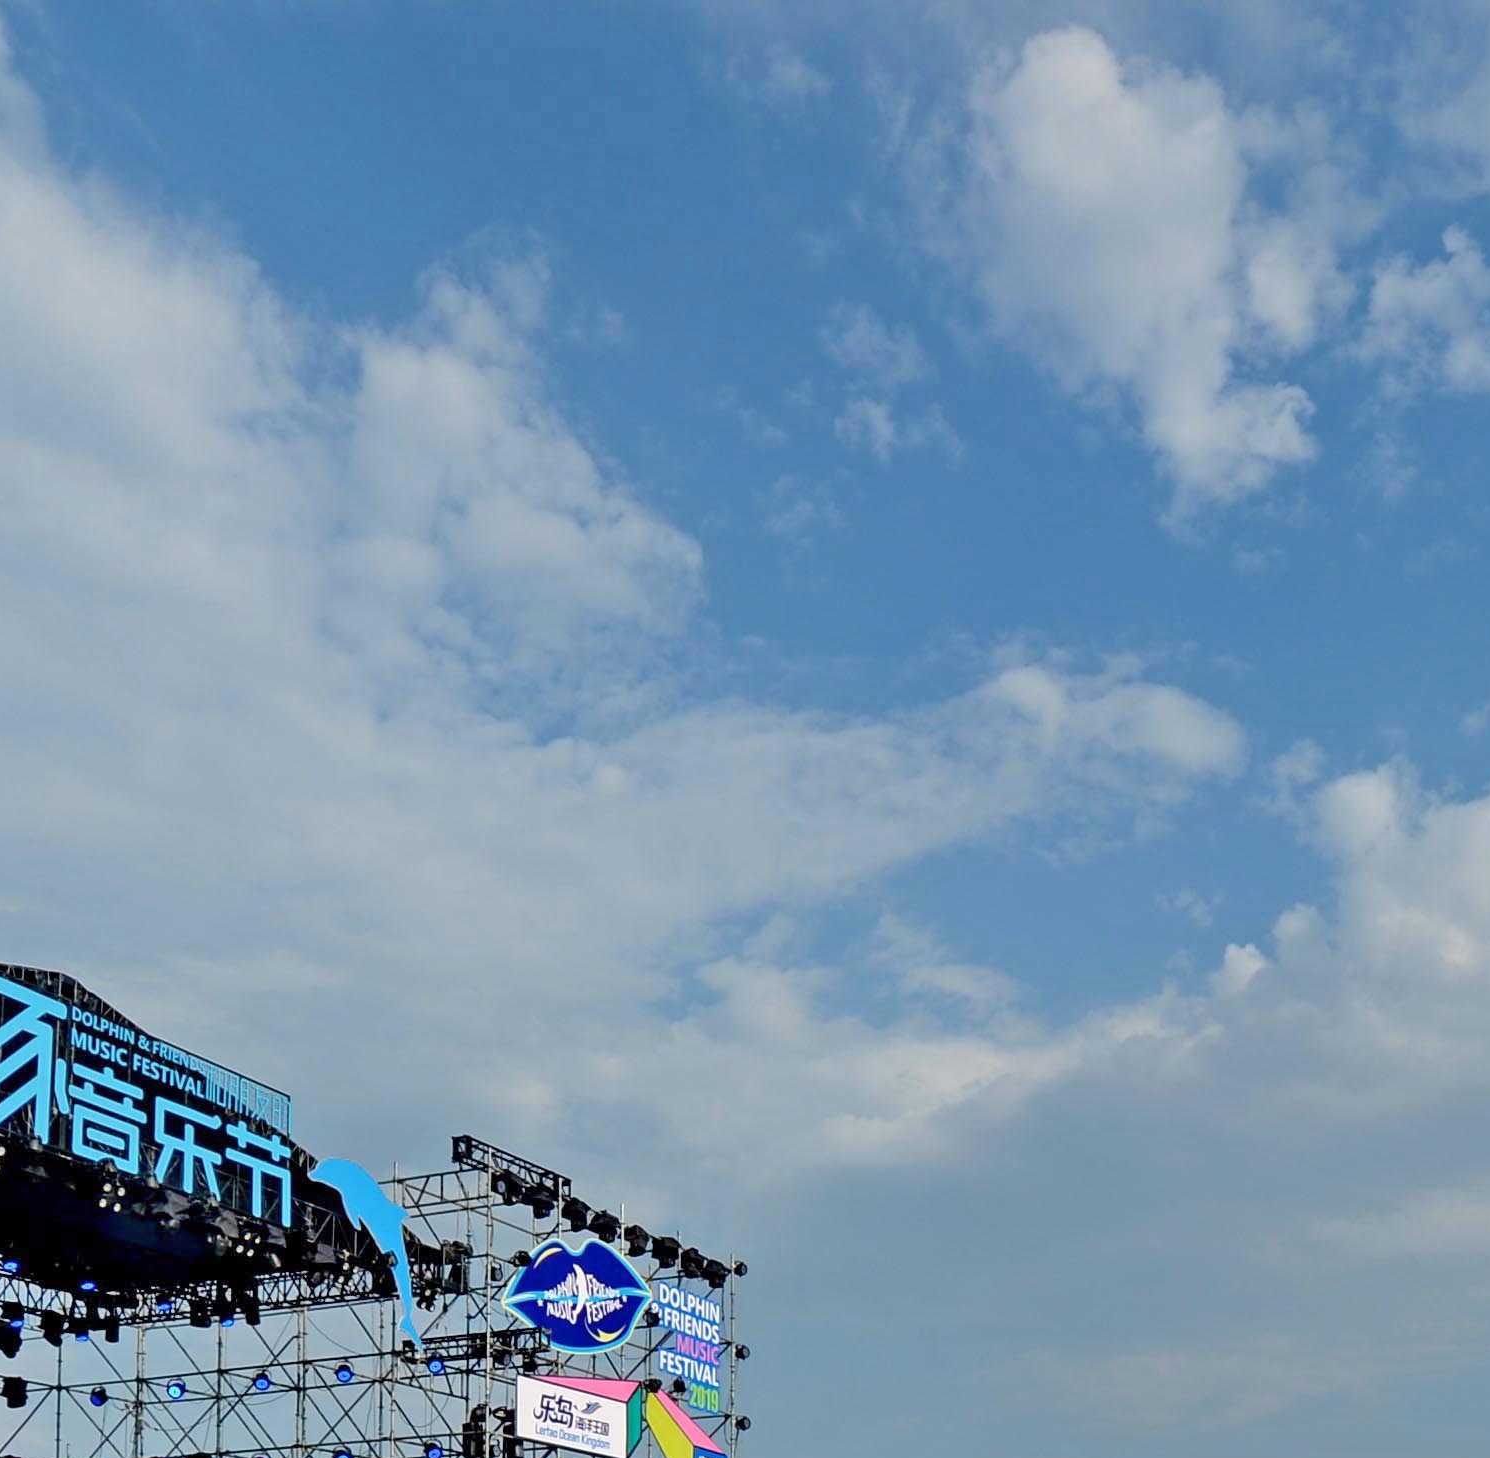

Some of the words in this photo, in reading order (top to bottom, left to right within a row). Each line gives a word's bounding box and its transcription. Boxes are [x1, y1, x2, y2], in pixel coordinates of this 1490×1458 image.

[72, 1005, 135, 1044] DOLPHIN
[138, 1034, 150, 1051] &
[152, 1041, 205, 1074] FRIENDS
[71, 1028, 127, 1067] MUSIC
[133, 1053, 204, 1098] FESTIVAL
[69, 1062, 292, 1228] 音乐节
[659, 1283, 719, 1324] DOLPHIN
[664, 1307, 719, 1345] FRIENDS
[660, 1350, 719, 1387] FESTIVAL
[677, 1334, 719, 1366] MUSIC
[533, 1393, 574, 1428] 乐岛
[690, 1383, 719, 1412] 2019
